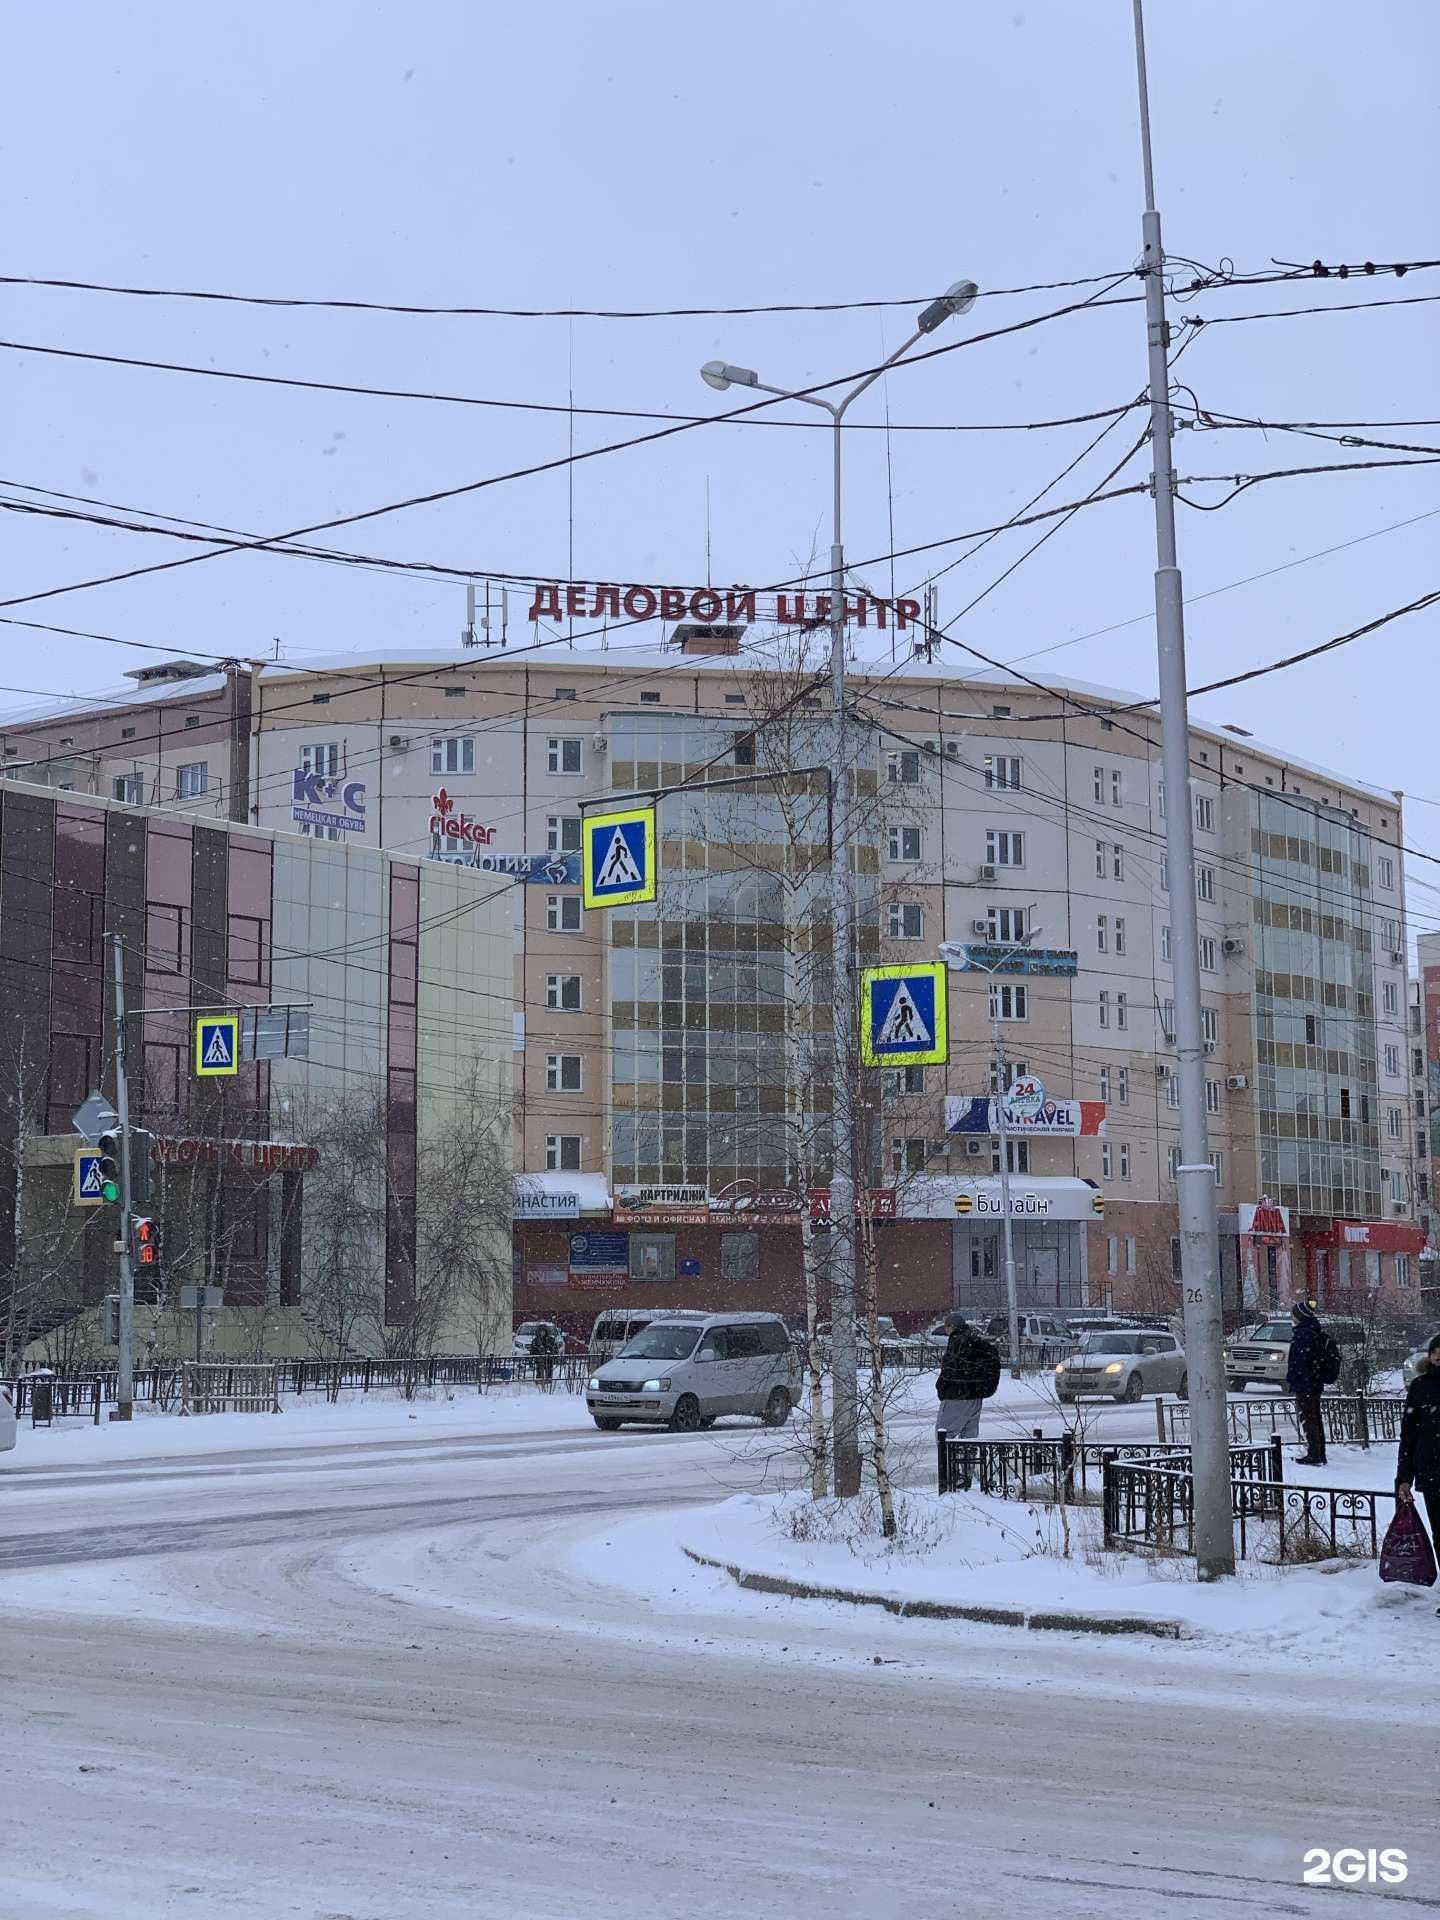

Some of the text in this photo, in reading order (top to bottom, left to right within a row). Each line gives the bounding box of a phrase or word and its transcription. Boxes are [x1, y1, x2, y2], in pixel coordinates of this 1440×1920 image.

[528, 584, 922, 631] ДЕЛОВОЙ ЦЕНТР
[293, 808, 366, 833] НЕМЕЦКАЯ ОБУВЬ
[430, 813, 497, 845] rieker
[1015, 1083, 1036, 1096] 24
[512, 1195, 576, 1209] ИНАСТИЯ
[641, 1189, 706, 1202] КАРТРИДЖИ
[662, 1215, 706, 1224] ОФИСНАЯ
[1186, 1288, 1203, 1303] 26
